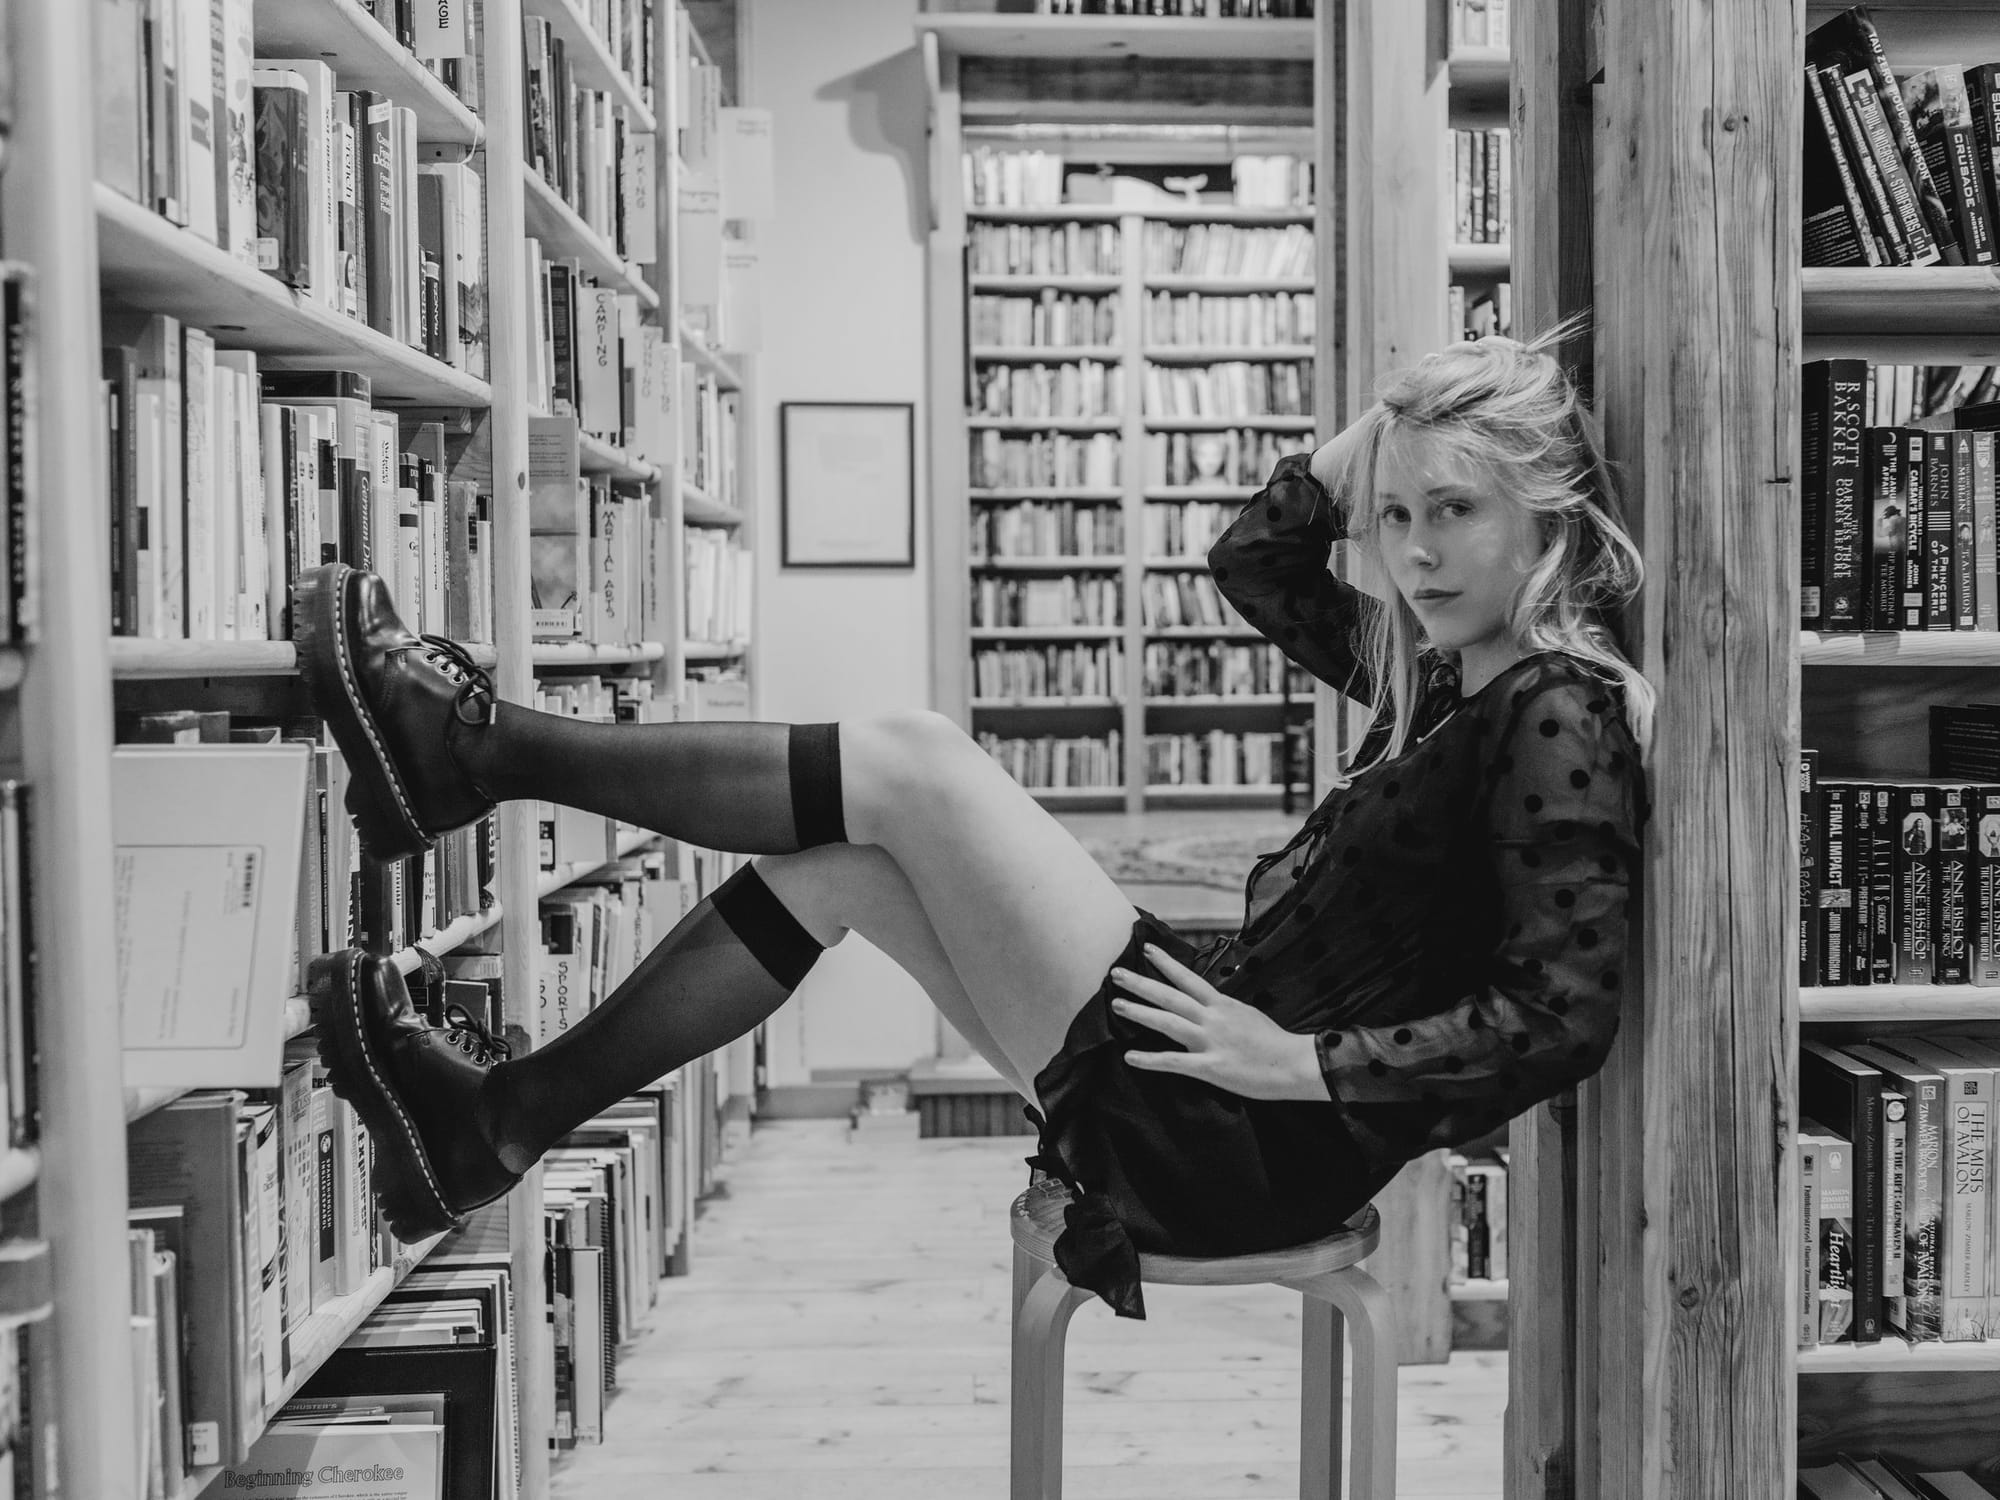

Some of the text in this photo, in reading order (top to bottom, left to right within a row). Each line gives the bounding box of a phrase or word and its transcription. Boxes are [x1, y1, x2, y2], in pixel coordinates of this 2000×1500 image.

[1868, 32, 1929, 180] TAU ZERO POUL ANDERSON
[345, 133, 353, 198] French
[1863, 104, 1922, 231] POUL ANDERSON STARFARERS
[1953, 133, 1976, 208] CRUSADE
[1969, 211, 1981, 249] ANDERSON
[1977, 216, 1987, 242] TAYLOR
[595, 293, 608, 367] CAMPING
[1832, 381, 1847, 466] BAKKER
[1846, 402, 1860, 467] SCOTT
[362, 476, 370, 541] German
[1881, 465, 1889, 496] AFFAIR
[1889, 456, 1897, 503] THE JANU
[1908, 469, 1919, 551] CAESAR'S BICYCLE
[1930, 457, 1939, 507] BARNES
[1939, 463, 1949, 500] JOHN
[1958, 466, 1967, 512] MERLIN
[1833, 478, 1844, 579] COMES BEFORE
[1842, 478, 1854, 578] DARKNESS THAT
[1851, 519, 1859, 536] THE
[1940, 544, 1949, 553] A
[602, 511, 616, 619] MARTIAL ARTS
[1880, 579, 1888, 612] MORRIS
[1888, 566, 1896, 616] BALLANTINE
[1931, 540, 1940, 617] OF THE AERIE
[1962, 572, 1971, 613] BARRON
[1829, 803, 1843, 887] FINAL IMPACT
[1873, 839, 1890, 901] ALIENS
[1857, 886, 1869, 924] PREDATOR
[1903, 871, 1911, 886] THE
[1903, 887, 1911, 913] HOUSE
[1953, 860, 1964, 959] ANNE BISHOP
[1877, 904, 1887, 935] GENOCIDE
[1903, 915, 1911, 924] OF
[1915, 862, 1926, 960] ANNE BISHOP
[1942, 864, 1951, 957] THE INVISIBLE RING
[1980, 866, 1989, 961] THE PILLARS OF THE WORLD
[1829, 911, 1841, 980] JOHN BIRMINGHAM
[558, 961, 568, 1029] SPORTS
[1894, 1138, 1904, 1148] IN
[1894, 1150, 1904, 1170] THE
[1919, 1103, 1929, 1192] ZIMMER BRADLEY
[1927, 1125, 1940, 1168] MARION
[1956, 1106, 1970, 1195] OF AVALON
[1970, 1110, 1985, 1193] THE MISTS
[1826, 1231, 1844, 1307] Heartlit
[1919, 1231, 1929, 1247] OF
[1917, 1250, 1930, 1302] AVALON
[1963, 1262, 1972, 1293] BRADLEY
[224, 1464, 404, 1490] Beginning Cherokee
